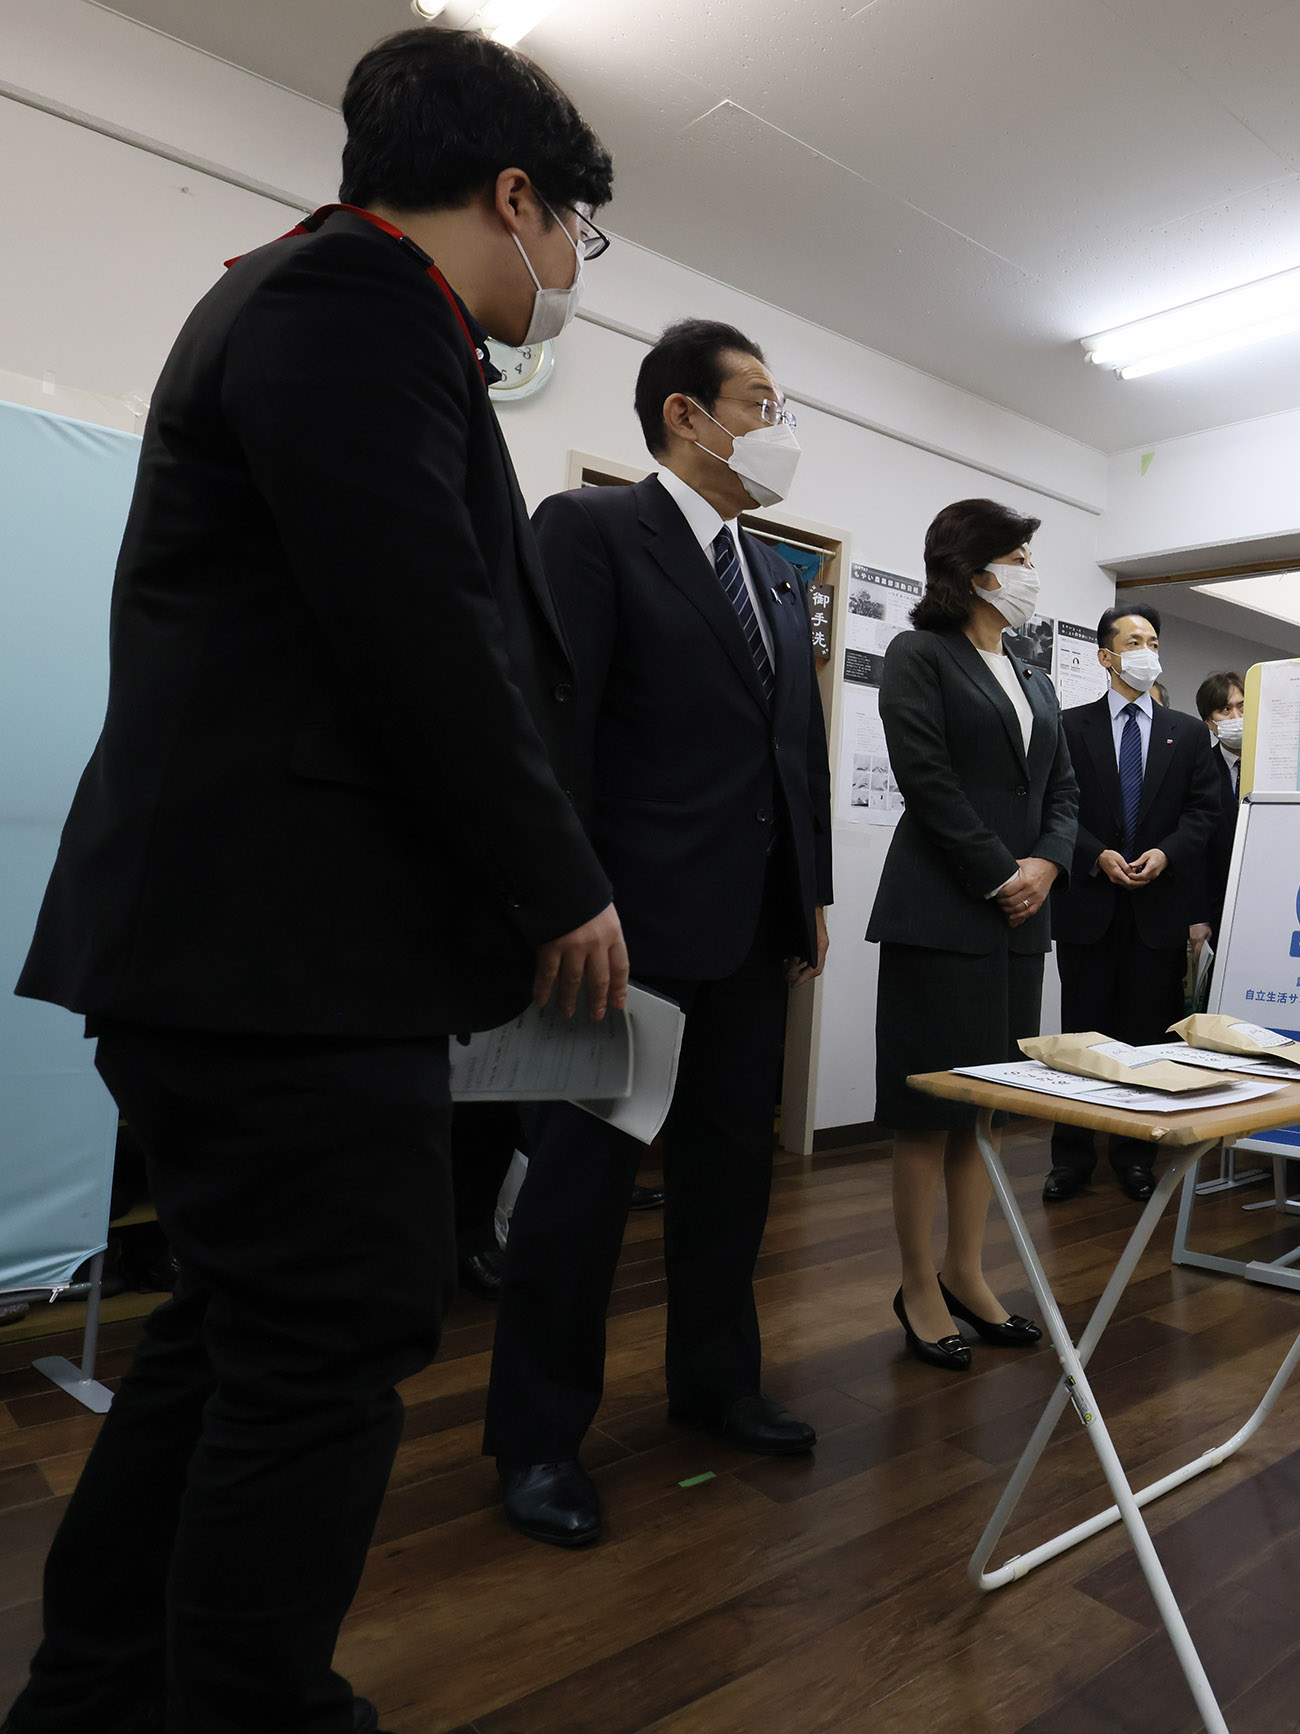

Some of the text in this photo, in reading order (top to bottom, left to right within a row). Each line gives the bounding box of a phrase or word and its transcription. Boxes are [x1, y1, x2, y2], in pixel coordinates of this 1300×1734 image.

[514, 362, 523, 375] 4
[811, 591, 830, 648] 御手洗
